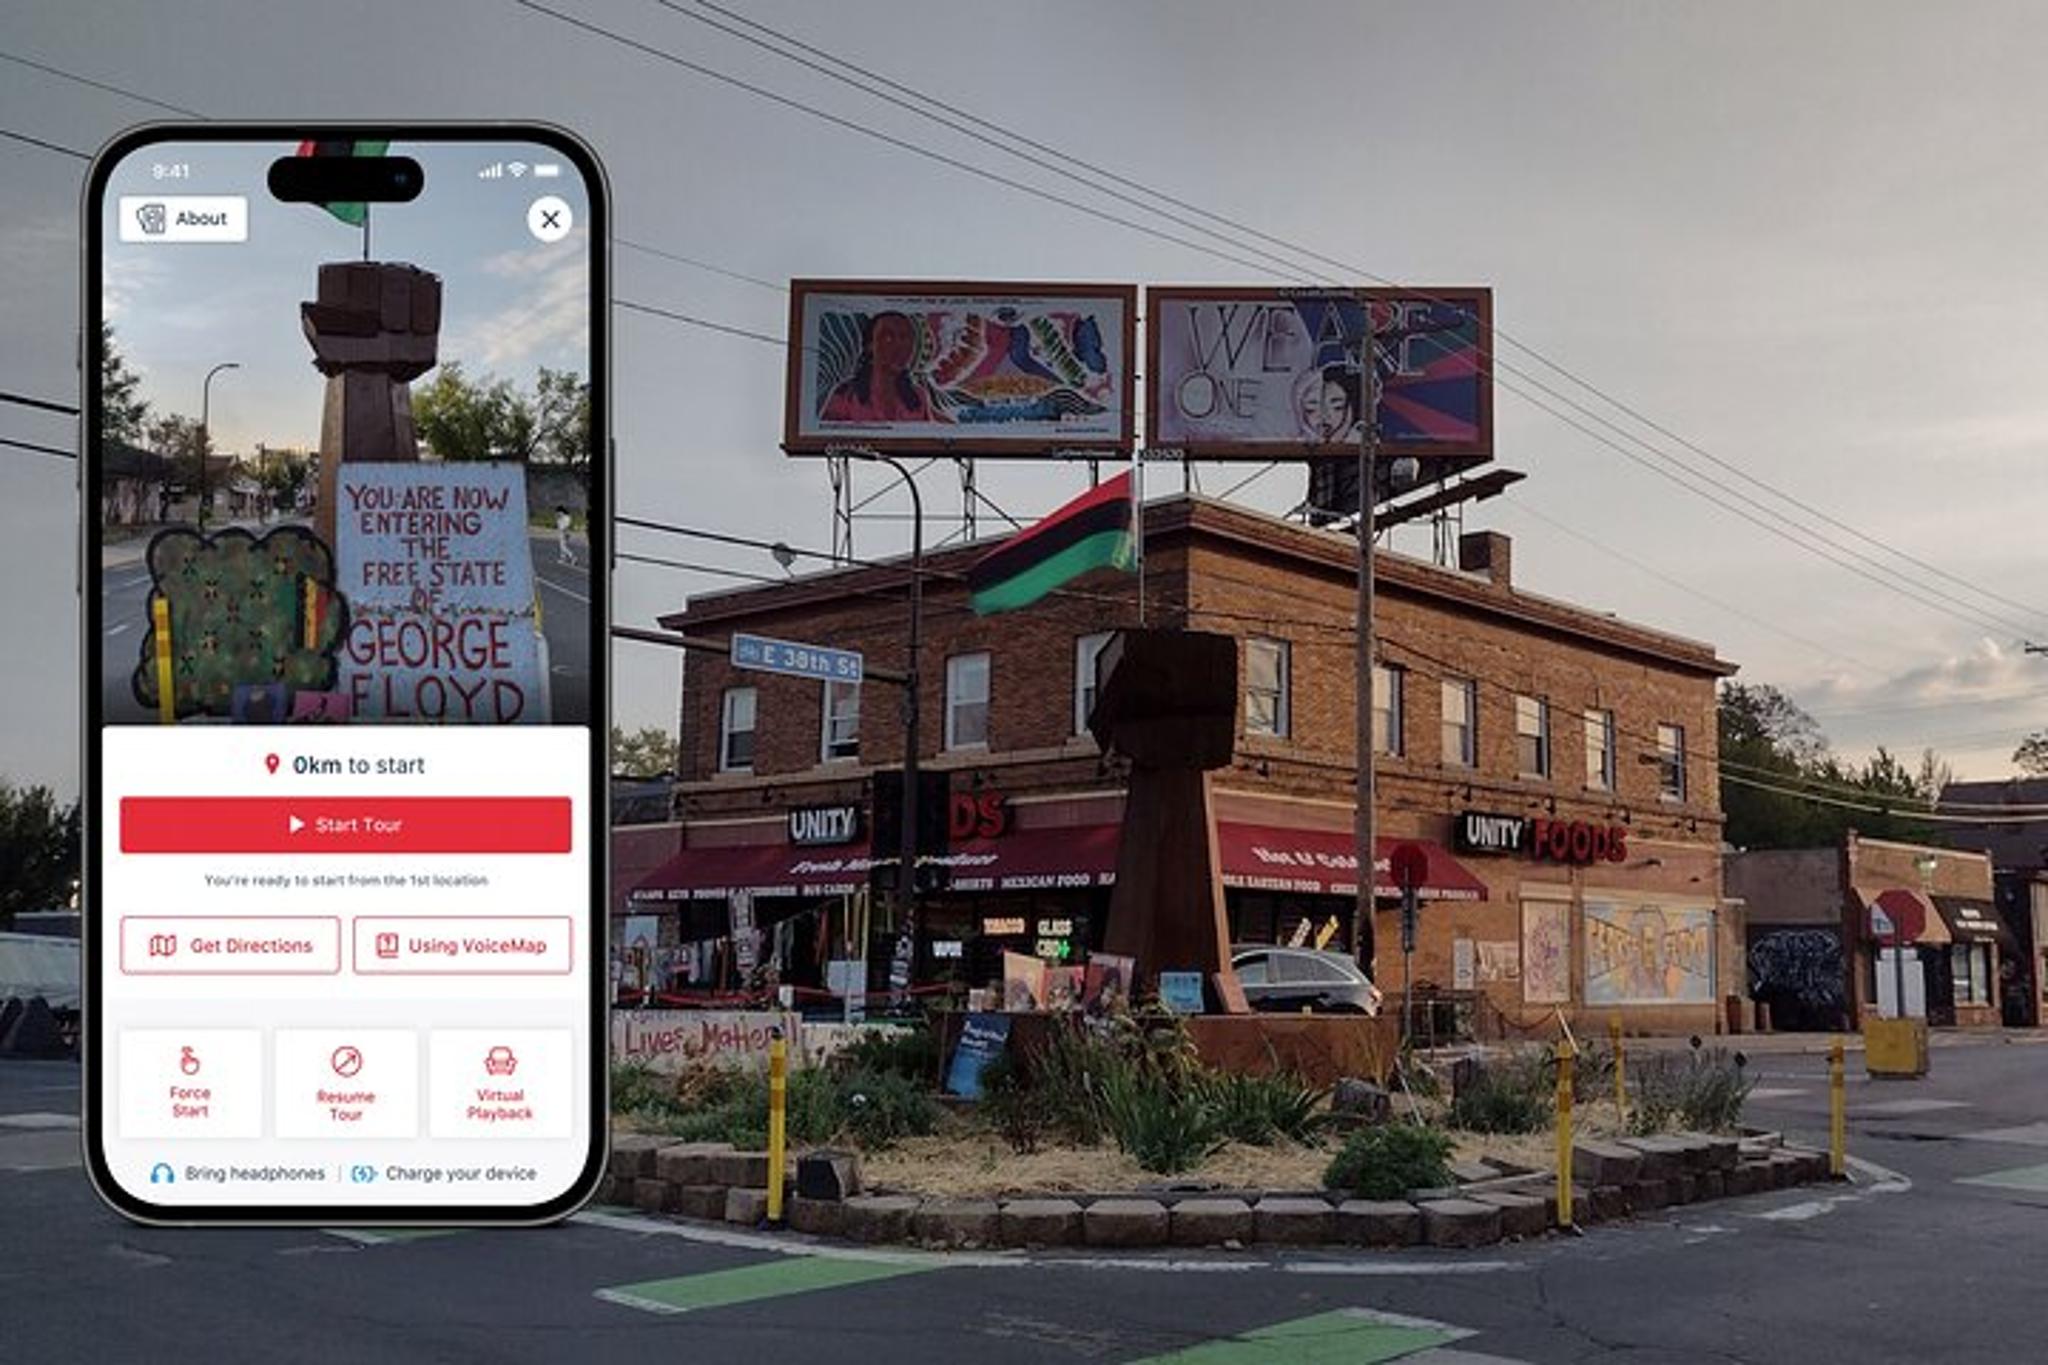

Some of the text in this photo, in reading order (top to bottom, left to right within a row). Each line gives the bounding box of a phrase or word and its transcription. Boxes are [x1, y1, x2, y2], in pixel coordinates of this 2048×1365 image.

[153, 165, 190, 179] 9:41
[176, 211, 227, 225] About
[1187, 304, 1296, 372] WE
[1177, 370, 1264, 419] ONE
[345, 484, 509, 511] YOU ARE NOW
[361, 512, 482, 535] ENTERING
[401, 536, 450, 559] THE
[363, 560, 505, 587] FREE STATE
[411, 586, 442, 615] OF
[346, 619, 511, 669] GEORGE
[763, 645, 774, 663] E
[837, 657, 857, 677] St
[350, 675, 525, 723] FLOYD
[293, 756, 424, 774] 0km to start
[315, 817, 402, 832] Start Tour
[790, 807, 854, 840] UNITY
[1467, 815, 1628, 862] UNITY FOODS
[204, 875, 488, 888] You're ready to start from the 1st location
[190, 938, 313, 954] Get Directions
[409, 939, 547, 956] Using VoiceMap
[170, 1086, 211, 1100] Force
[317, 1091, 374, 1103] Resume
[477, 1090, 524, 1101] Virtual
[173, 1105, 208, 1117] Start
[330, 1108, 362, 1121] Tour
[467, 1106, 532, 1122] Playback
[186, 1166, 325, 1183] Bring headphones
[386, 1166, 537, 1183] Charge your device
